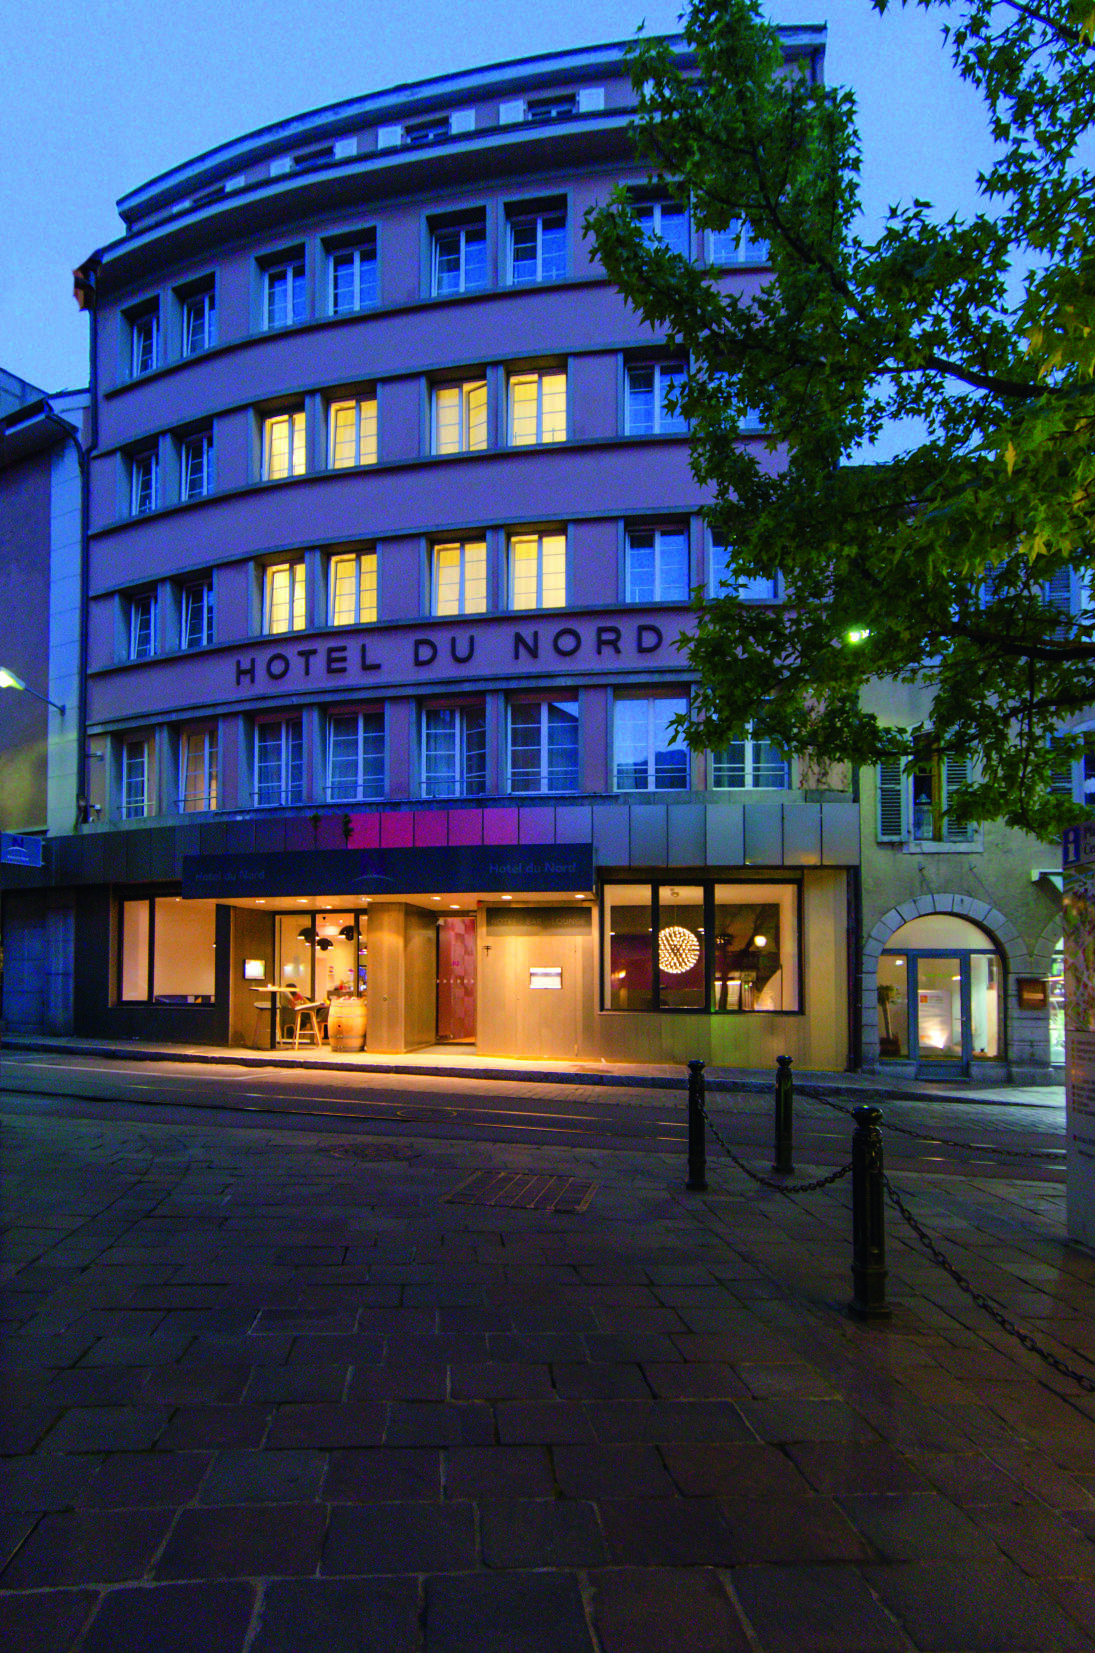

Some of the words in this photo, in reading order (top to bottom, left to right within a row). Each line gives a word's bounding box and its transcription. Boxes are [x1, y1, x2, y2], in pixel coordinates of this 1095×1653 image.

[236, 643, 381, 685] HOTEL
[414, 634, 476, 667] DU
[514, 624, 664, 660] NORD
[490, 863, 522, 874] Hotel
[526, 862, 541, 873] du
[545, 862, 577, 873] Nord
[239, 869, 266, 880] Nord
